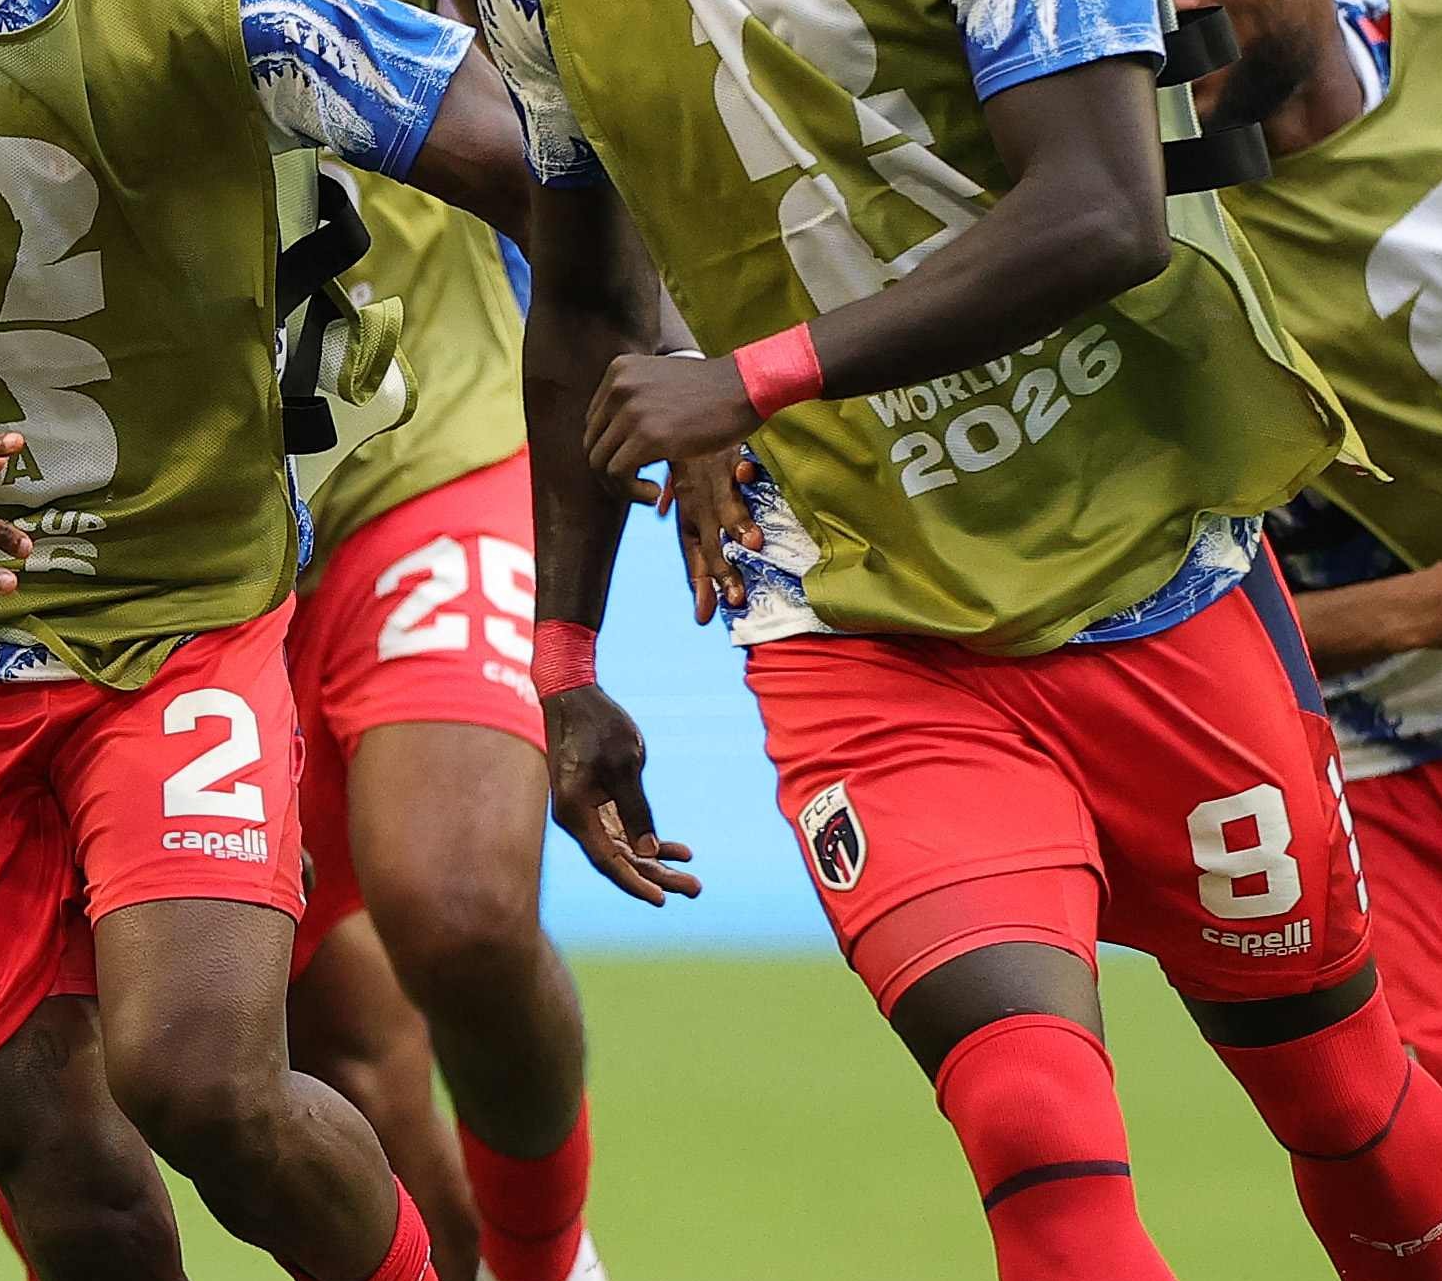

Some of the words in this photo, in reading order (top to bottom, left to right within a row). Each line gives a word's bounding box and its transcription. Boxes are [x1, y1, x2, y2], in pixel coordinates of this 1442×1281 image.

[867, 355, 1013, 428] WORLD
[890, 323, 1123, 499] 2026
[375, 534, 536, 664] 25
[163, 688, 266, 822] 2
[804, 786, 838, 830] FCF
[163, 828, 267, 855] capelli
[214, 849, 268, 865] SPORT
[1186, 783, 1302, 919] 8
[1202, 919, 1312, 954] capelli
[1251, 943, 1312, 957] SPORT
